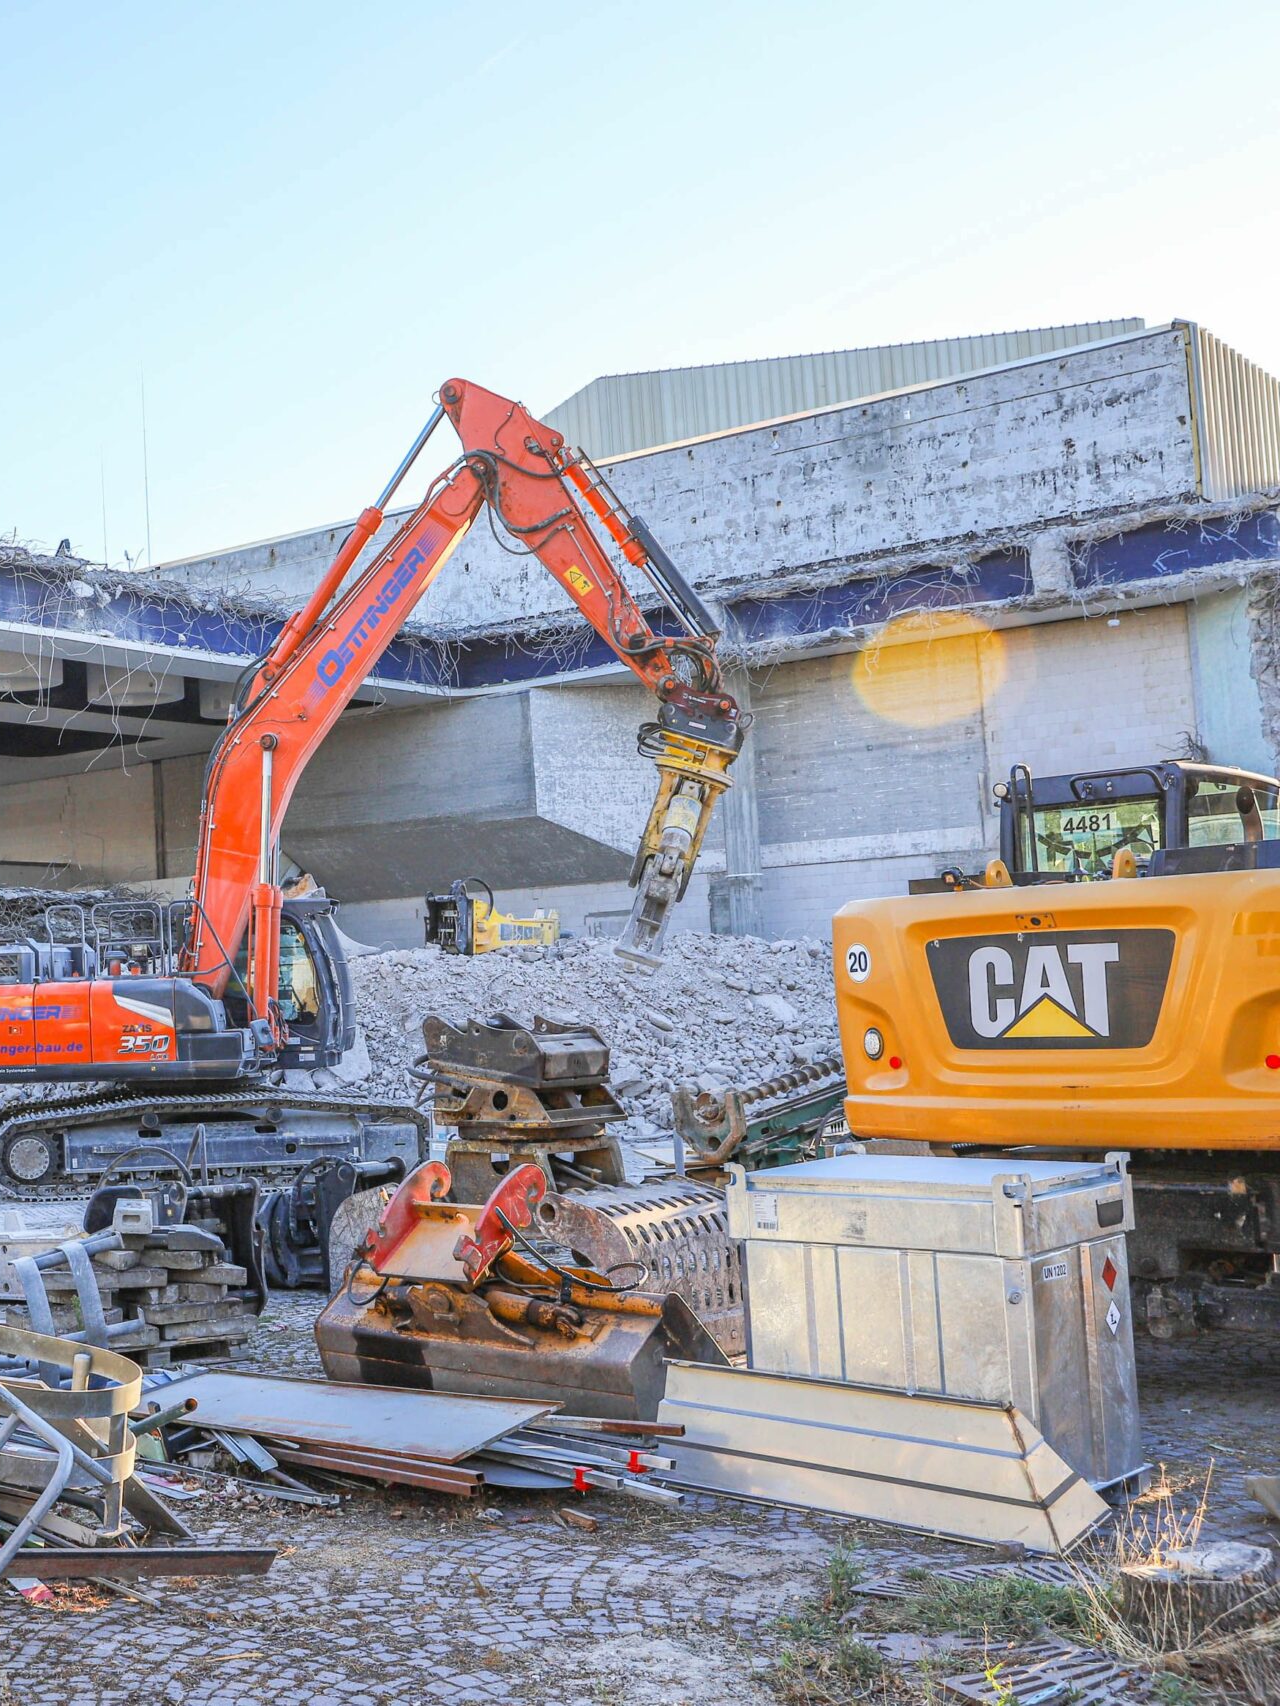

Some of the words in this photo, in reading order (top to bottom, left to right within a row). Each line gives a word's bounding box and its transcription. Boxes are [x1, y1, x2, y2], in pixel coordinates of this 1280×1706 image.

[316, 546, 426, 688] OETTINGER
[1063, 813, 1111, 834] 4481
[848, 950, 868, 973] 20
[968, 942, 1120, 1038] CAT
[118, 1035, 170, 1053] 350
[1043, 1267, 1053, 1279] UN
[1053, 1264, 1067, 1277] 1202
